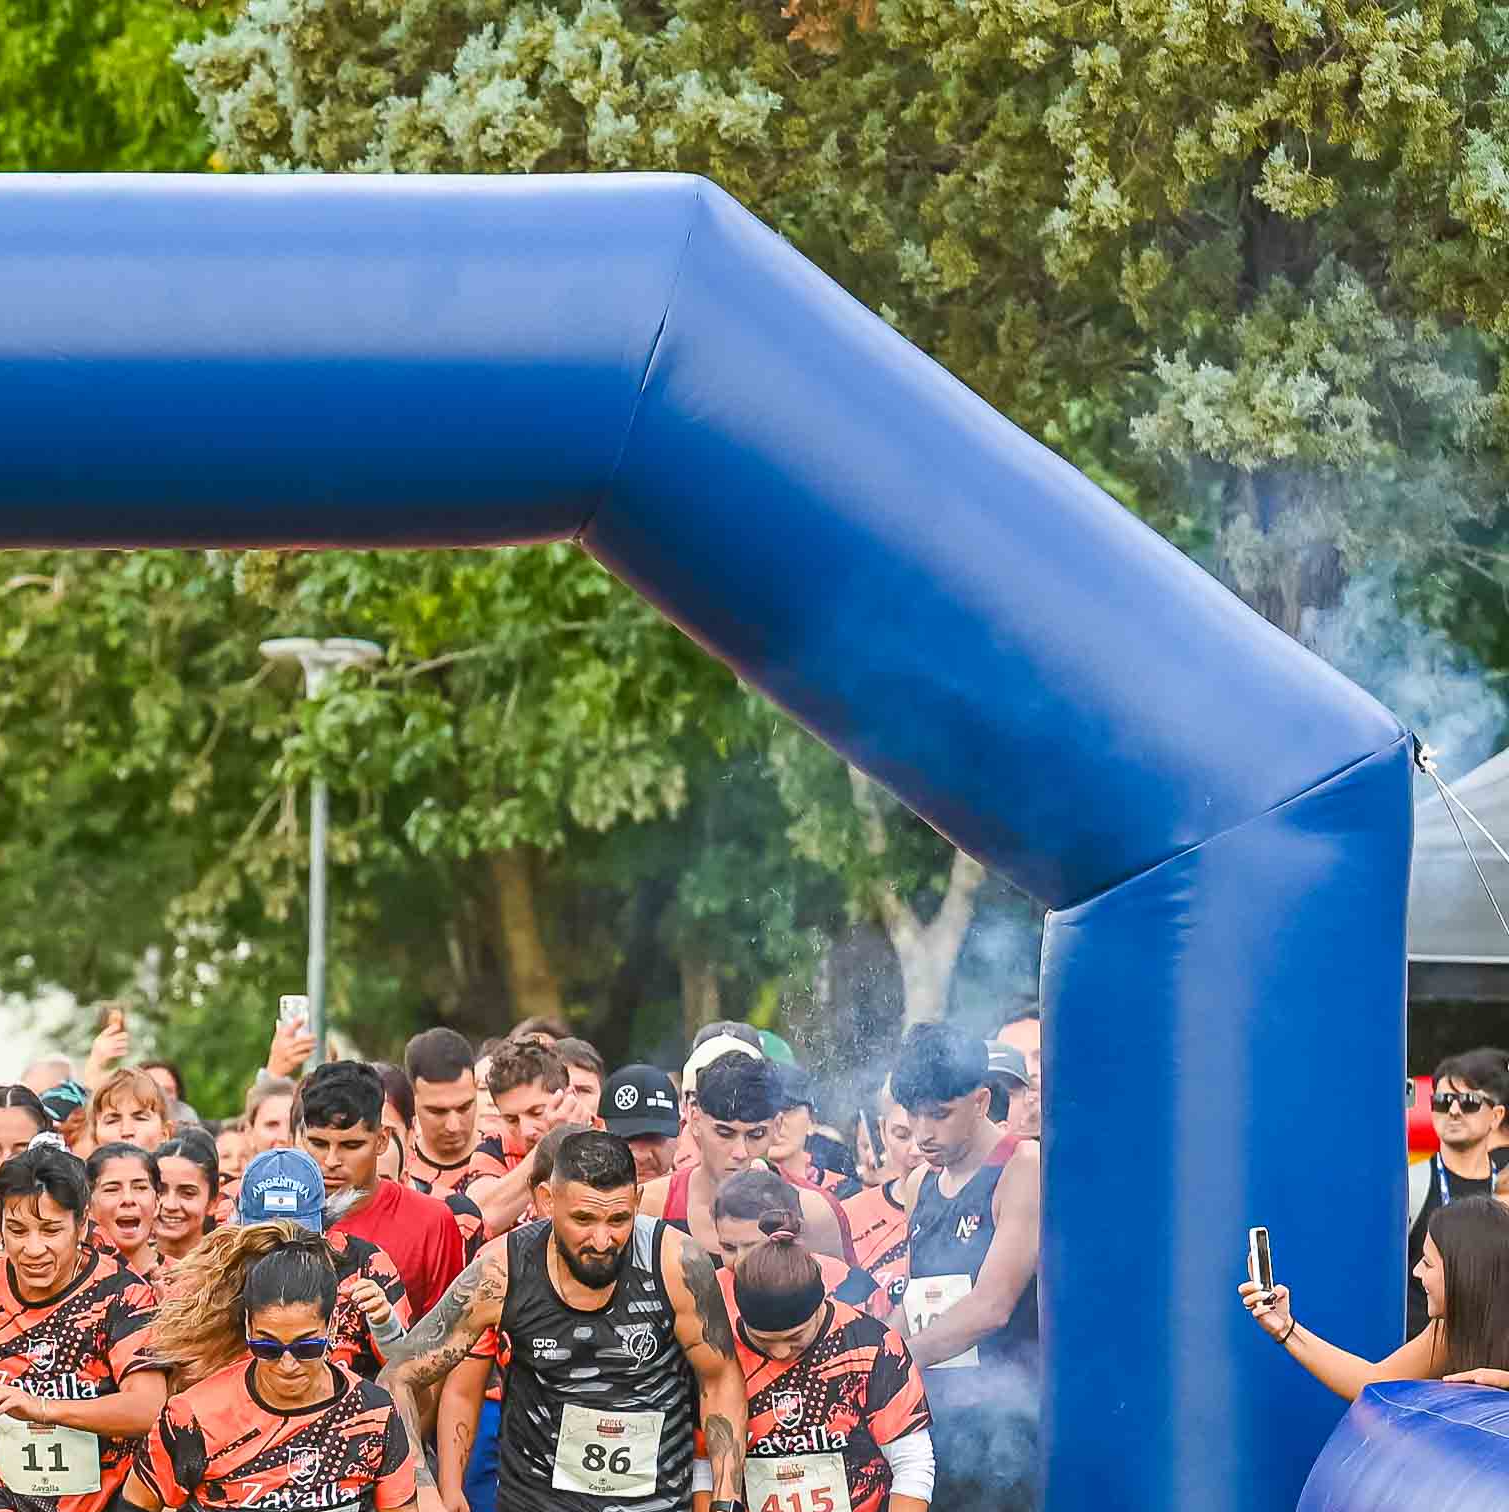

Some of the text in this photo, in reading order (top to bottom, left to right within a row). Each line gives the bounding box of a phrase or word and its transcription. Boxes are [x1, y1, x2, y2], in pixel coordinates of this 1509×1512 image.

[252, 1176, 310, 1200] ARGENTINA
[21, 1442, 69, 1472] 11
[582, 1443, 631, 1475] 86
[240, 1481, 357, 1510] Zavalla
